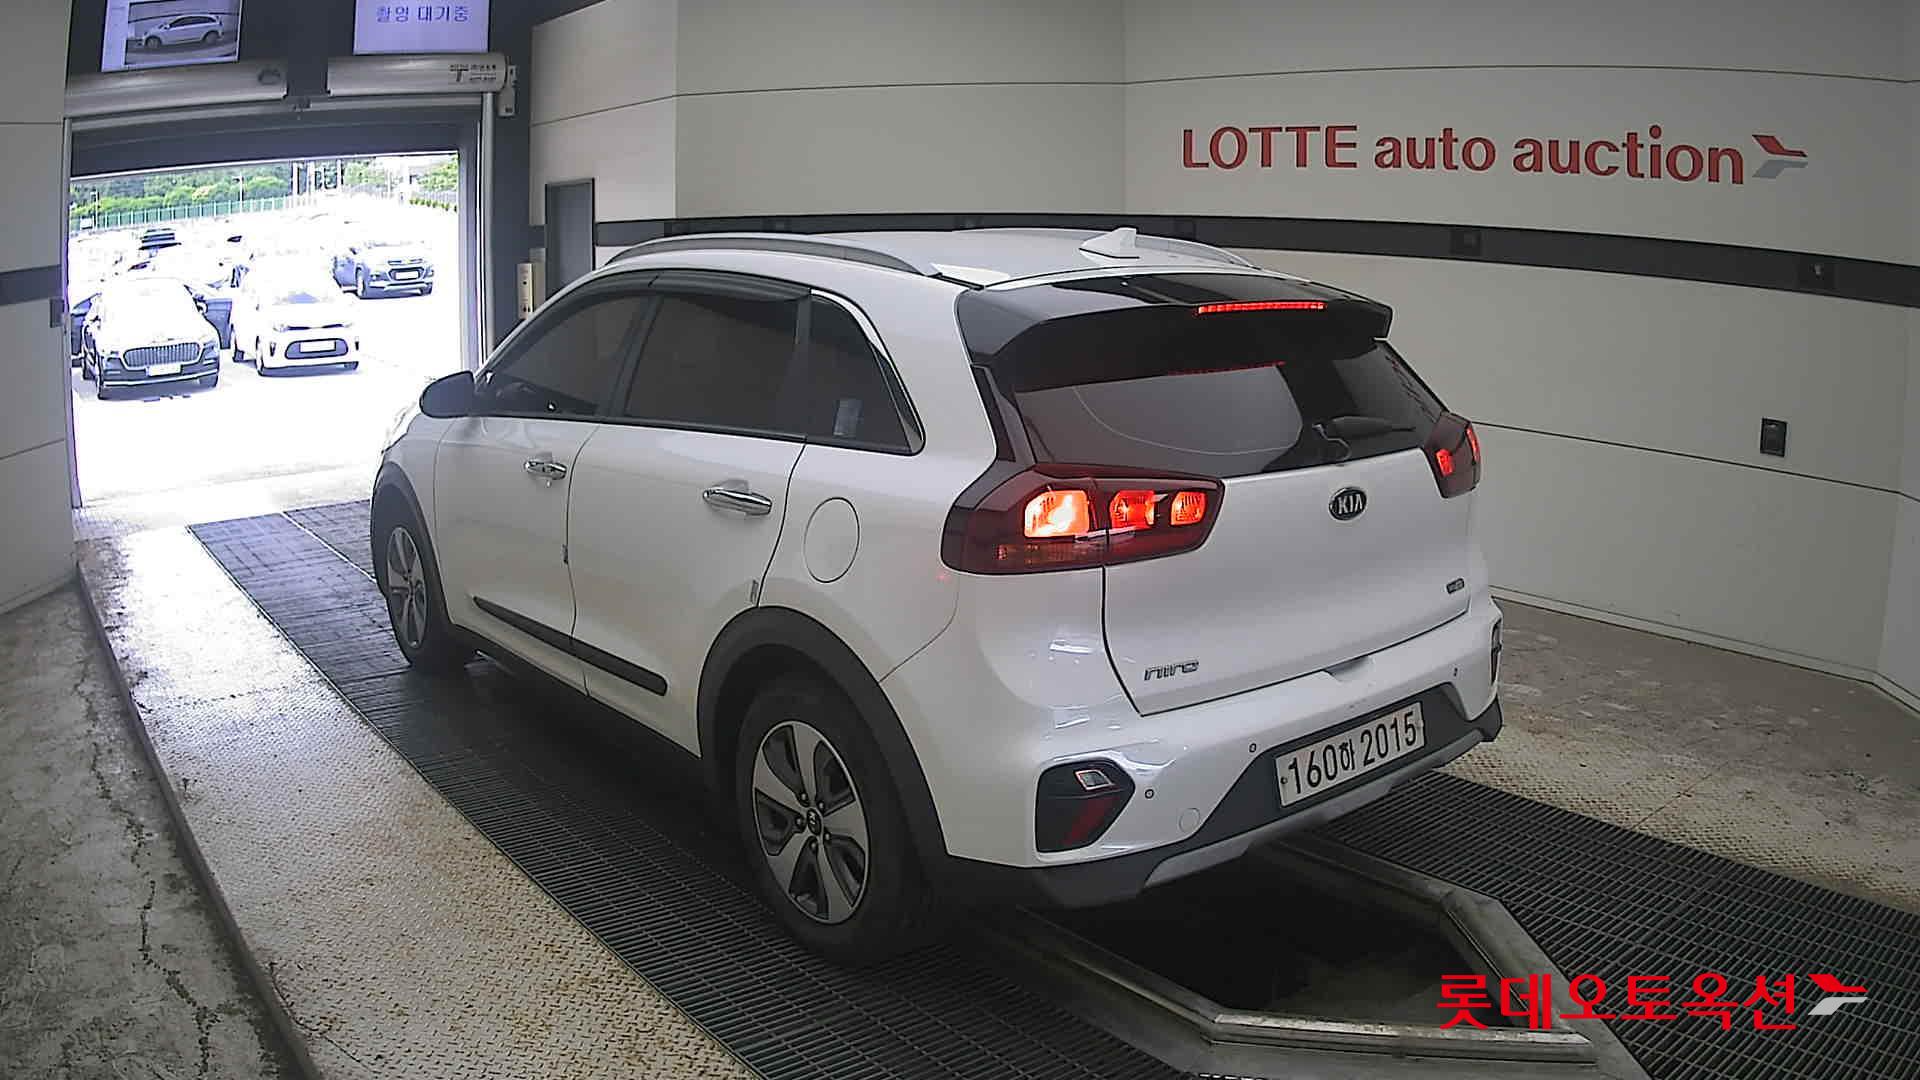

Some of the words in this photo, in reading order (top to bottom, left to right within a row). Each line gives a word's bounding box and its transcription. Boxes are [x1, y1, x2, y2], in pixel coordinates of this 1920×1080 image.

[418, 5, 469, 22] 대기중
[1182, 125, 1358, 170] LOTTE
[1374, 127, 1496, 171] auto
[1513, 124, 1744, 184] auction
[1338, 493, 1363, 515] KIA
[1360, 711, 1417, 767] 2015
